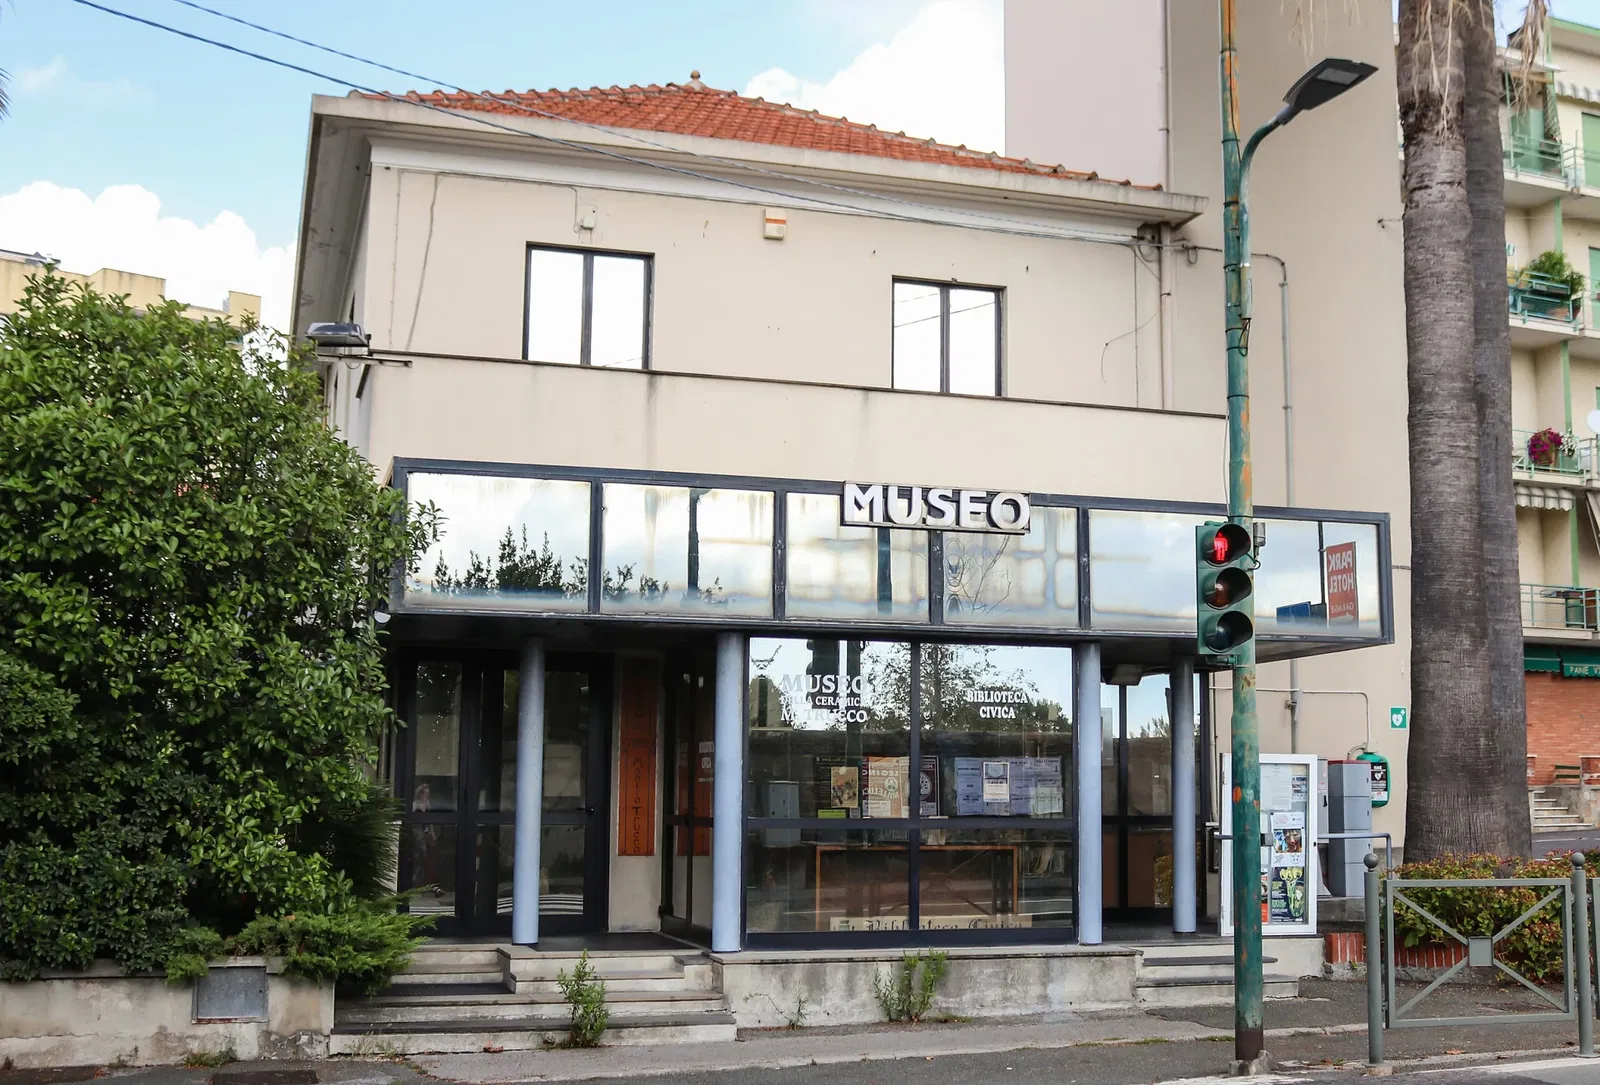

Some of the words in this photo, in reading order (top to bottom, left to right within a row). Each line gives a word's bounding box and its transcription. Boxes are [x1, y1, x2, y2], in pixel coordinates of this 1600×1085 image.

[844, 483, 1030, 530] MUSEO
[1570, 666, 1589, 675] PANE
[782, 675, 868, 693] MUSEO
[967, 690, 1029, 704] BIBLIOTECA
[804, 709, 868, 722] TRUCCO
[980, 706, 1016, 719] CIVICA
